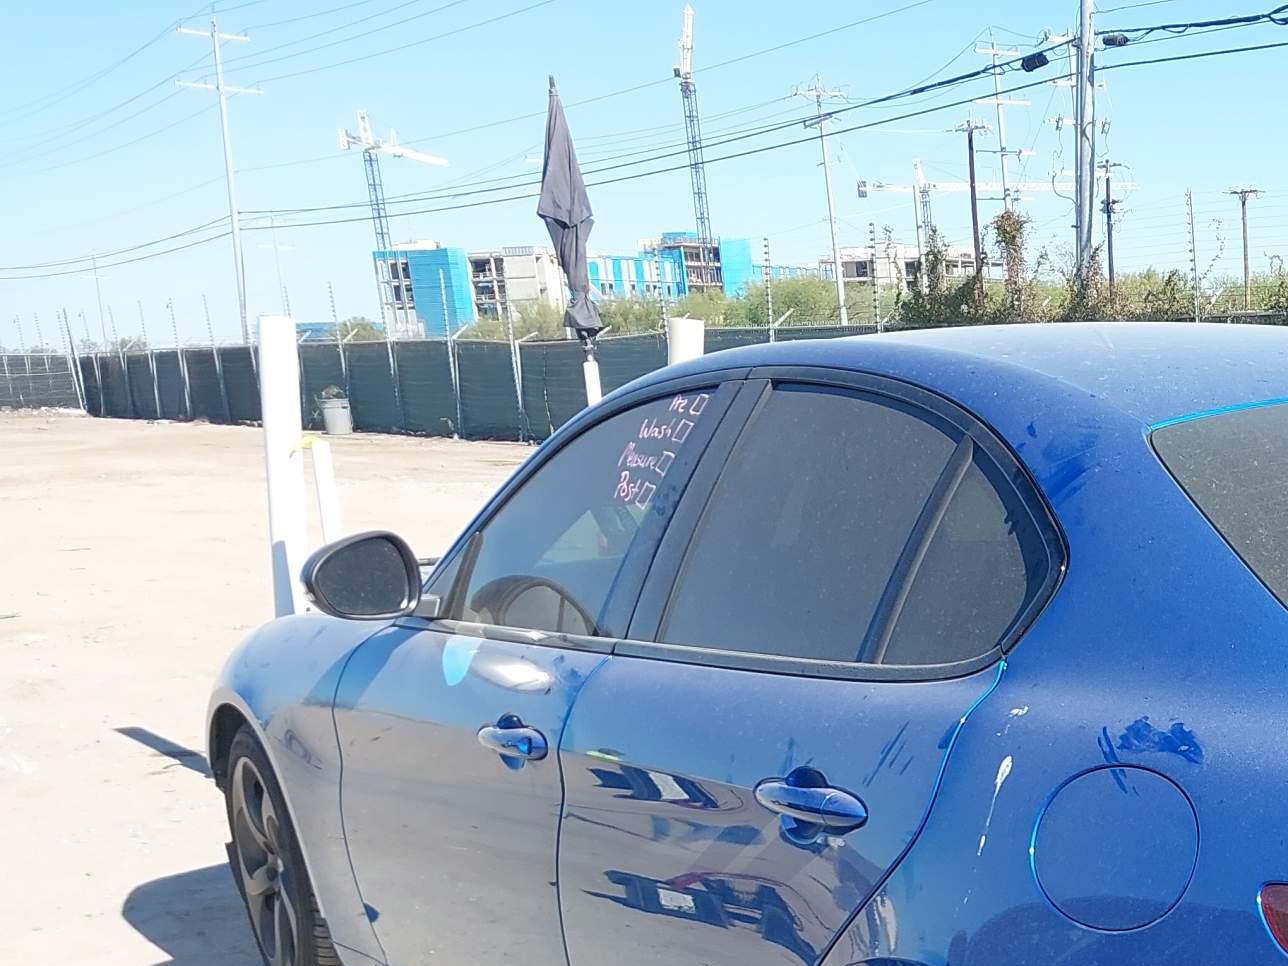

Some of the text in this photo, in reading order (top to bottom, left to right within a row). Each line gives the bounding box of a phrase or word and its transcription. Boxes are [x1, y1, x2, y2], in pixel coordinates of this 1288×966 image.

[669, 394, 688, 412] Pre
[639, 418, 676, 439] Wash
[614, 470, 641, 501] Post
